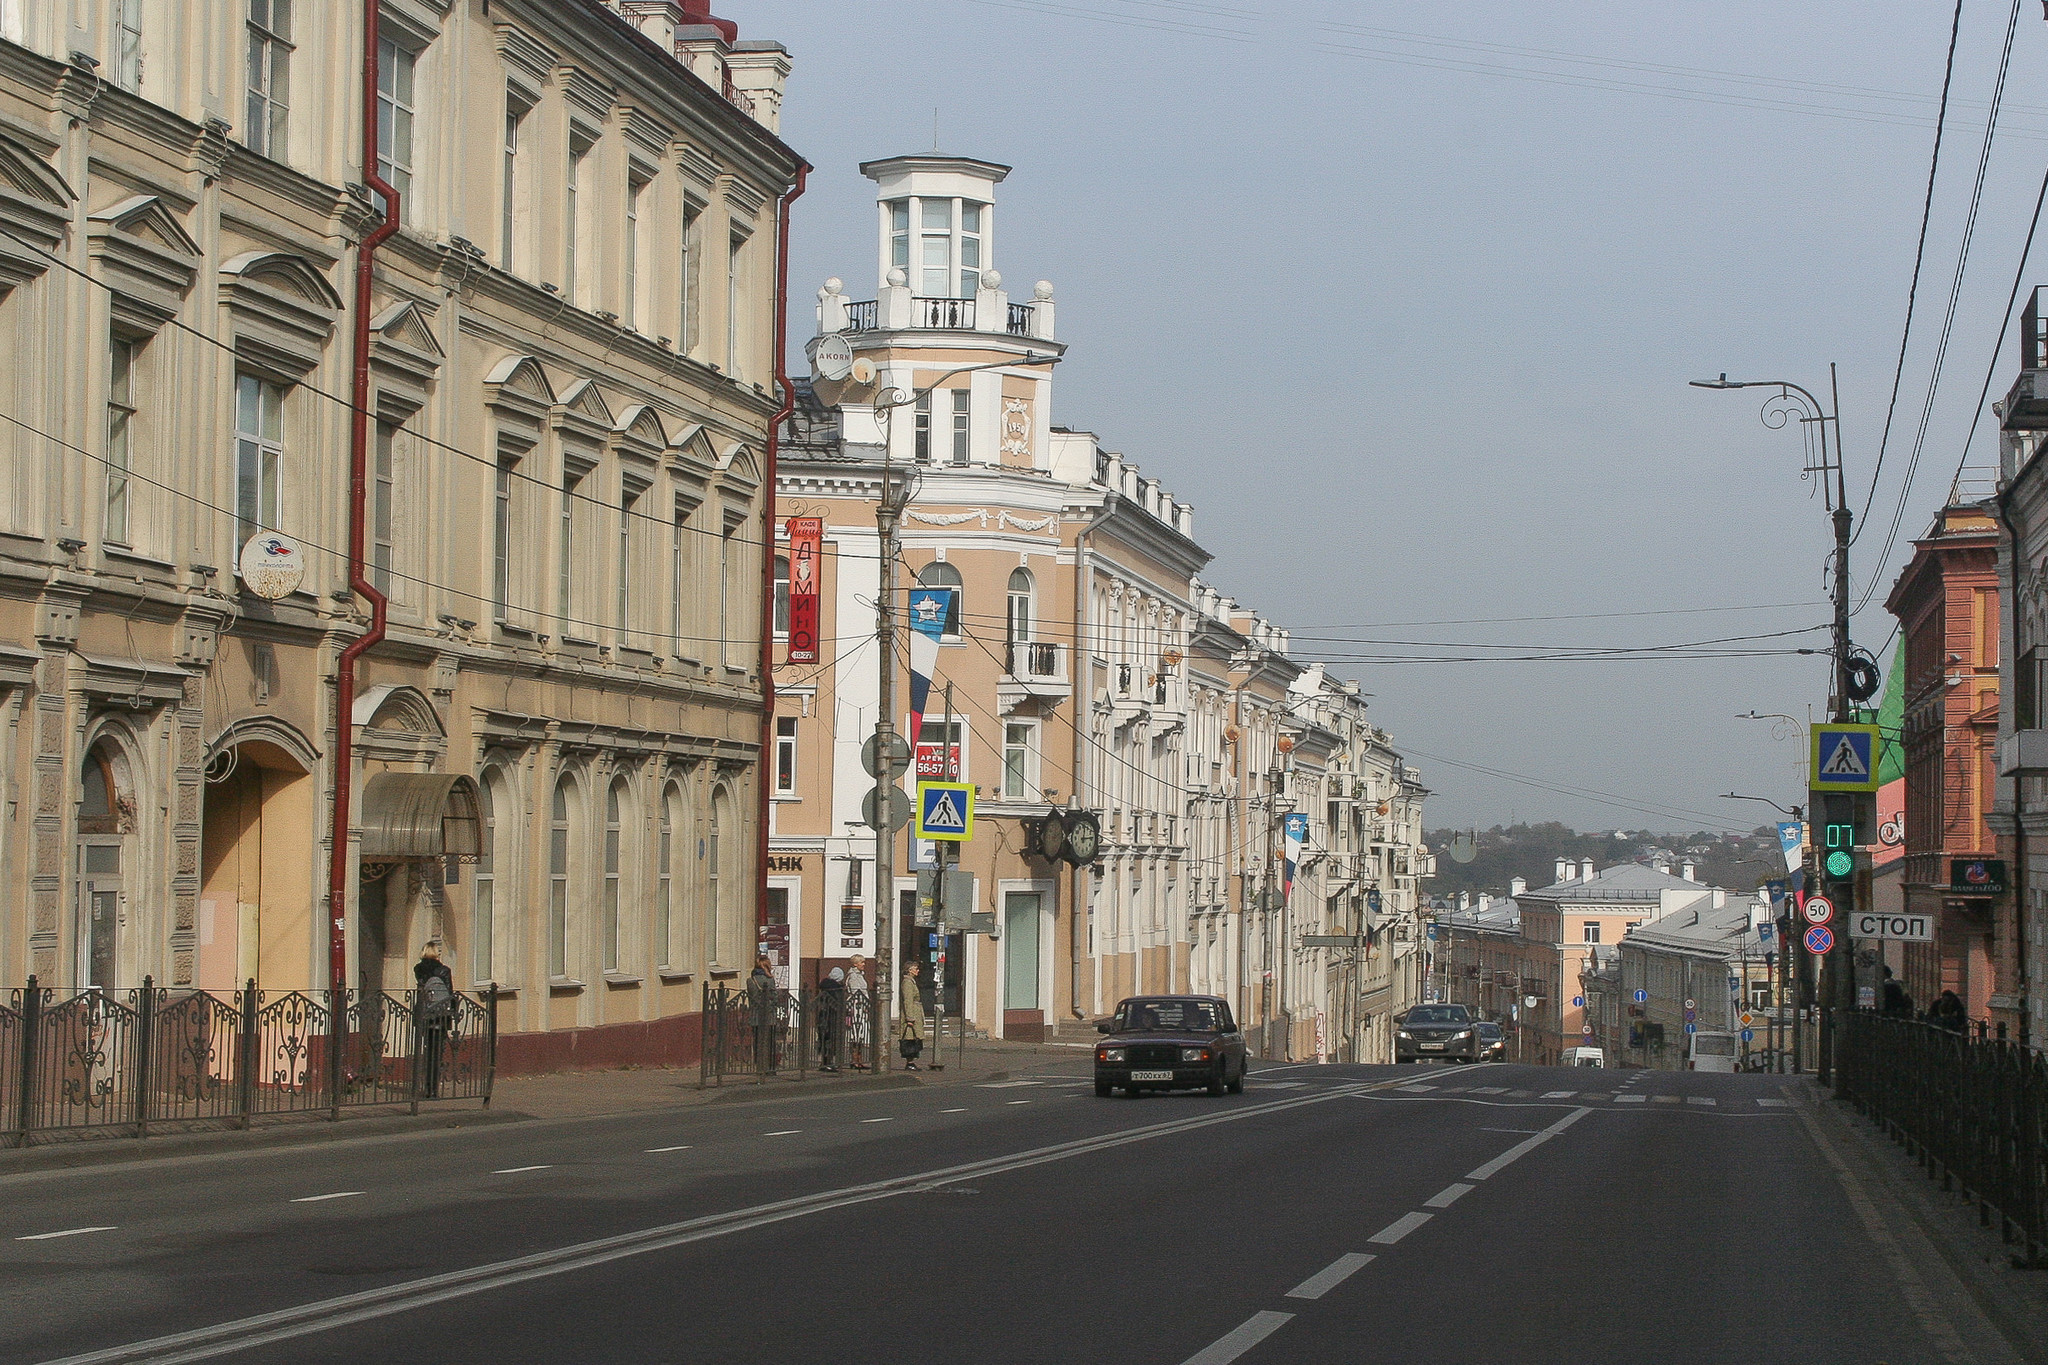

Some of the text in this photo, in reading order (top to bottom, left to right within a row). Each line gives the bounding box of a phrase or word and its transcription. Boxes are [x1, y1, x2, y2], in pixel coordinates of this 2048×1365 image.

[793, 541, 812, 649] ДОМИНО
[920, 755, 957, 763] АРЕНА
[1810, 905, 1825, 916] 50
[1860, 916, 1925, 936] СТОП
